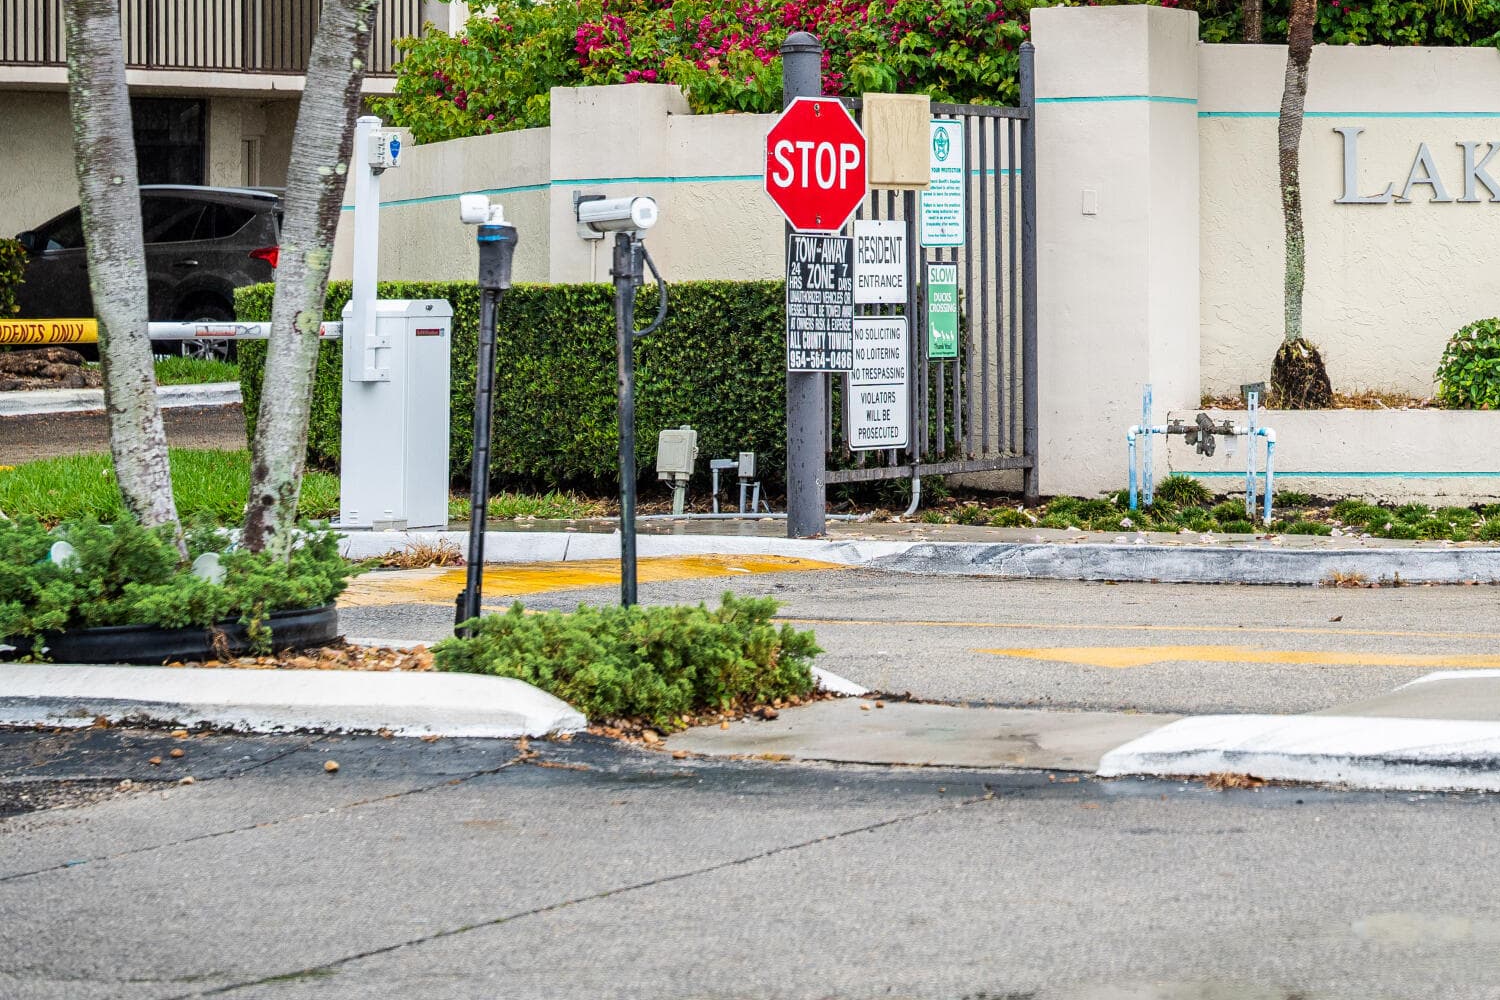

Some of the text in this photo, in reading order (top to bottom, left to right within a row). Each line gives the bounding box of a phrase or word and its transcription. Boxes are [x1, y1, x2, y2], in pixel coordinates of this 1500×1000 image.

[772, 139, 860, 190] STOP
[795, 237, 847, 264] TOW-AWAY
[858, 236, 903, 264] RESIDENT
[791, 261, 801, 275] 24
[842, 263, 849, 277] 7
[930, 267, 955, 282] SLOW
[790, 275, 802, 289] HRS
[806, 263, 835, 289] ZONE
[858, 274, 903, 288] ENTRANCE
[838, 277, 852, 291] DAYS
[790, 290, 822, 303] UNAUTHORIZED
[822, 291, 844, 304] VEHICLES
[933, 292, 952, 302] DUCKS
[807, 304, 818, 317] WILL
[818, 305, 825, 317] BE
[825, 305, 841, 318] TOWED
[929, 303, 957, 313] CROSSING
[815, 318, 826, 331] RISK
[831, 318, 852, 331] EXPENSE
[790, 331, 852, 350] ALL COUNTY TOWING
[854, 328, 901, 340] NO SOLICITING
[790, 351, 852, 369] 954-564-0486
[855, 348, 900, 360] NO LOITERING
[851, 367, 905, 380] NO TRESPASSING
[860, 392, 896, 404] VIOLATORS
[866, 409, 891, 421] WILL BE
[858, 426, 899, 440] PROSECUTED
